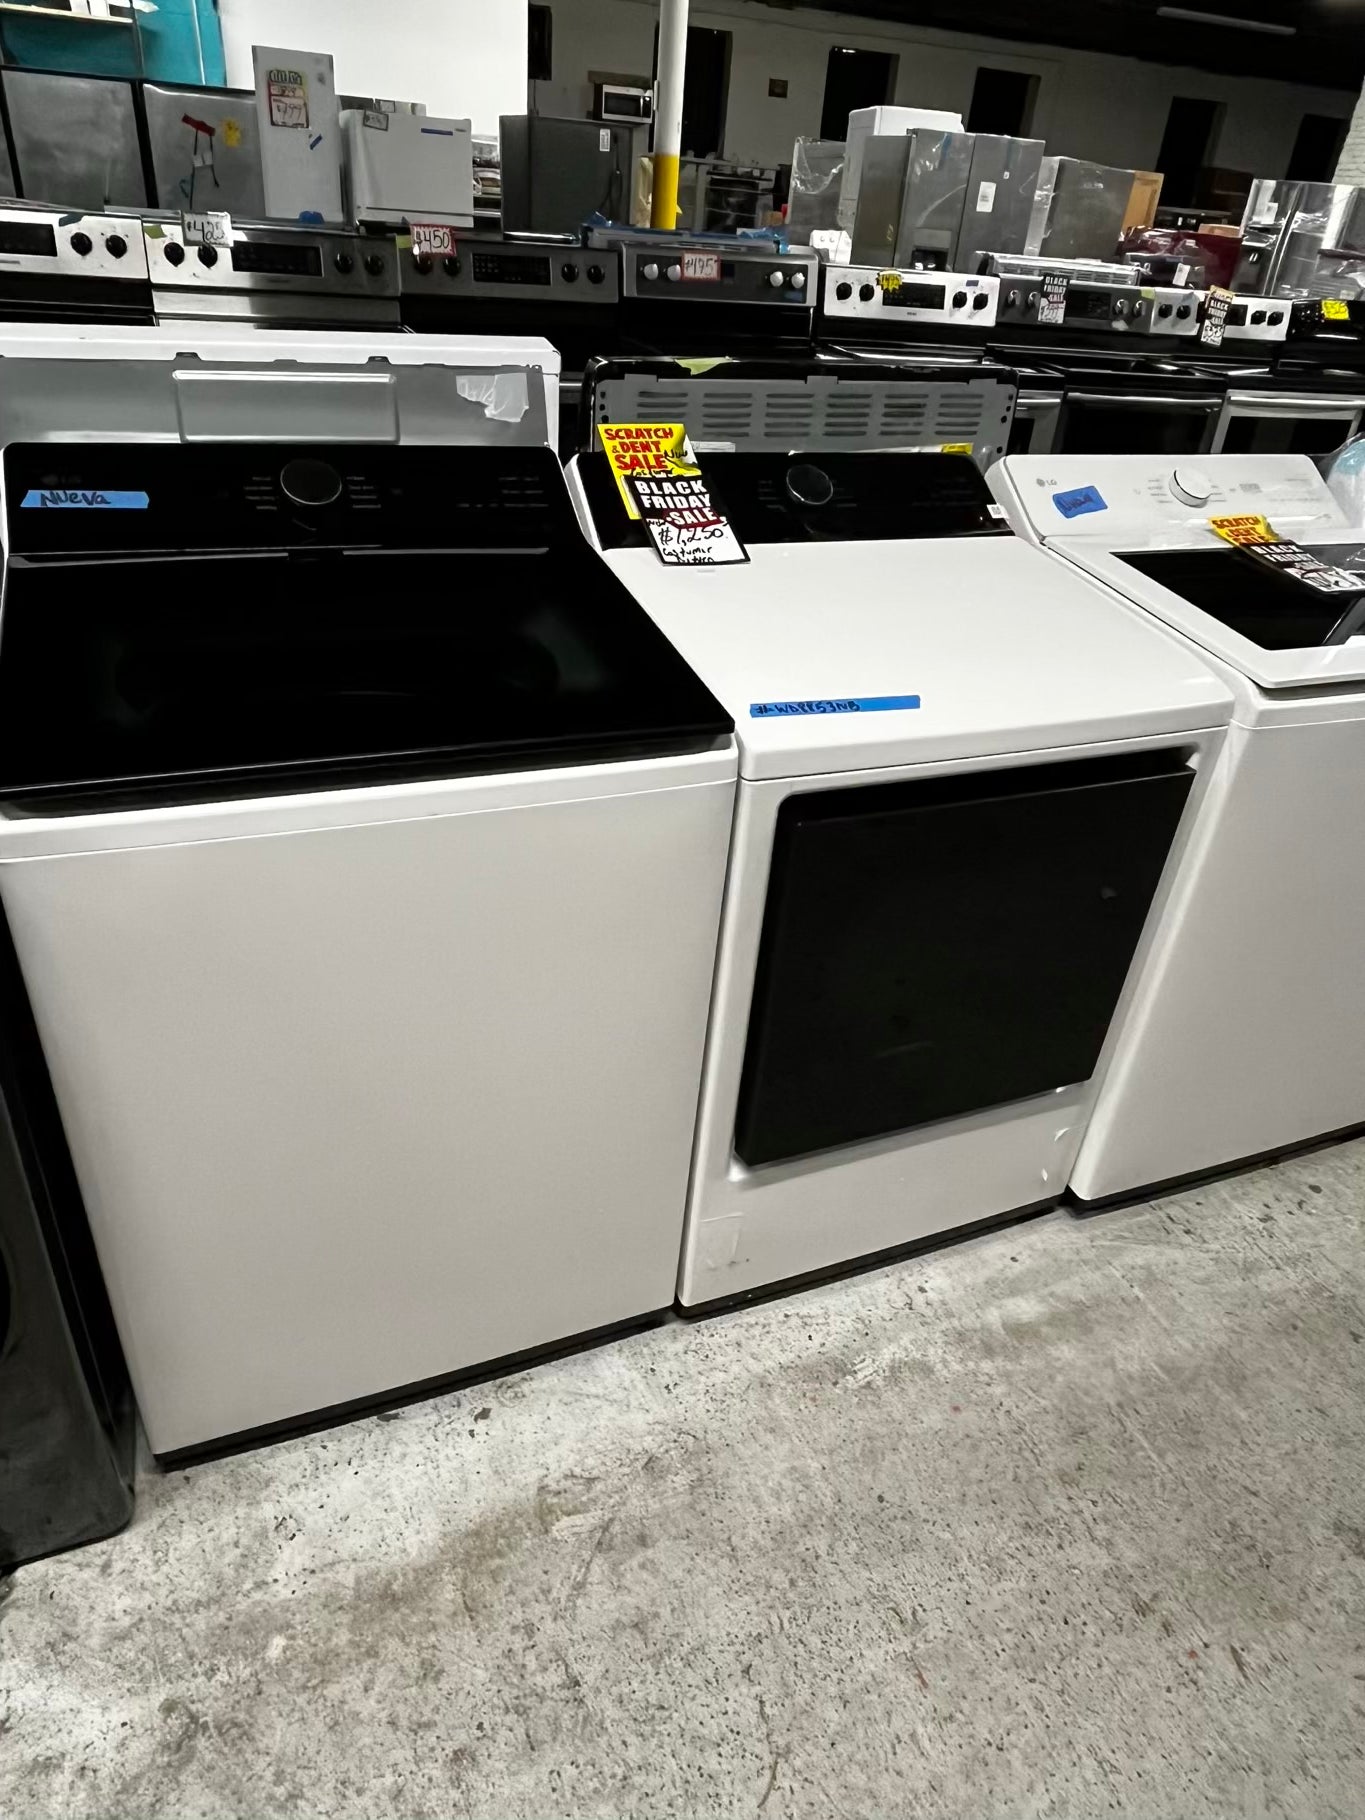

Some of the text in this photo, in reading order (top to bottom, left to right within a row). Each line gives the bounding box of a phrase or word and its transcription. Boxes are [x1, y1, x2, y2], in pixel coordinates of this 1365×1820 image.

[414, 229, 450, 251] $450
[603, 427, 674, 441] SCRATCH
[612, 440, 662, 454] & DENT
[614, 453, 668, 471] SALE
[634, 479, 707, 496] BLACK
[640, 494, 712, 510] FRIDAY
[668, 507, 718, 526] SALE
[1211, 516, 1262, 529] SCRATCH
[1249, 544, 1305, 555] BLACK
